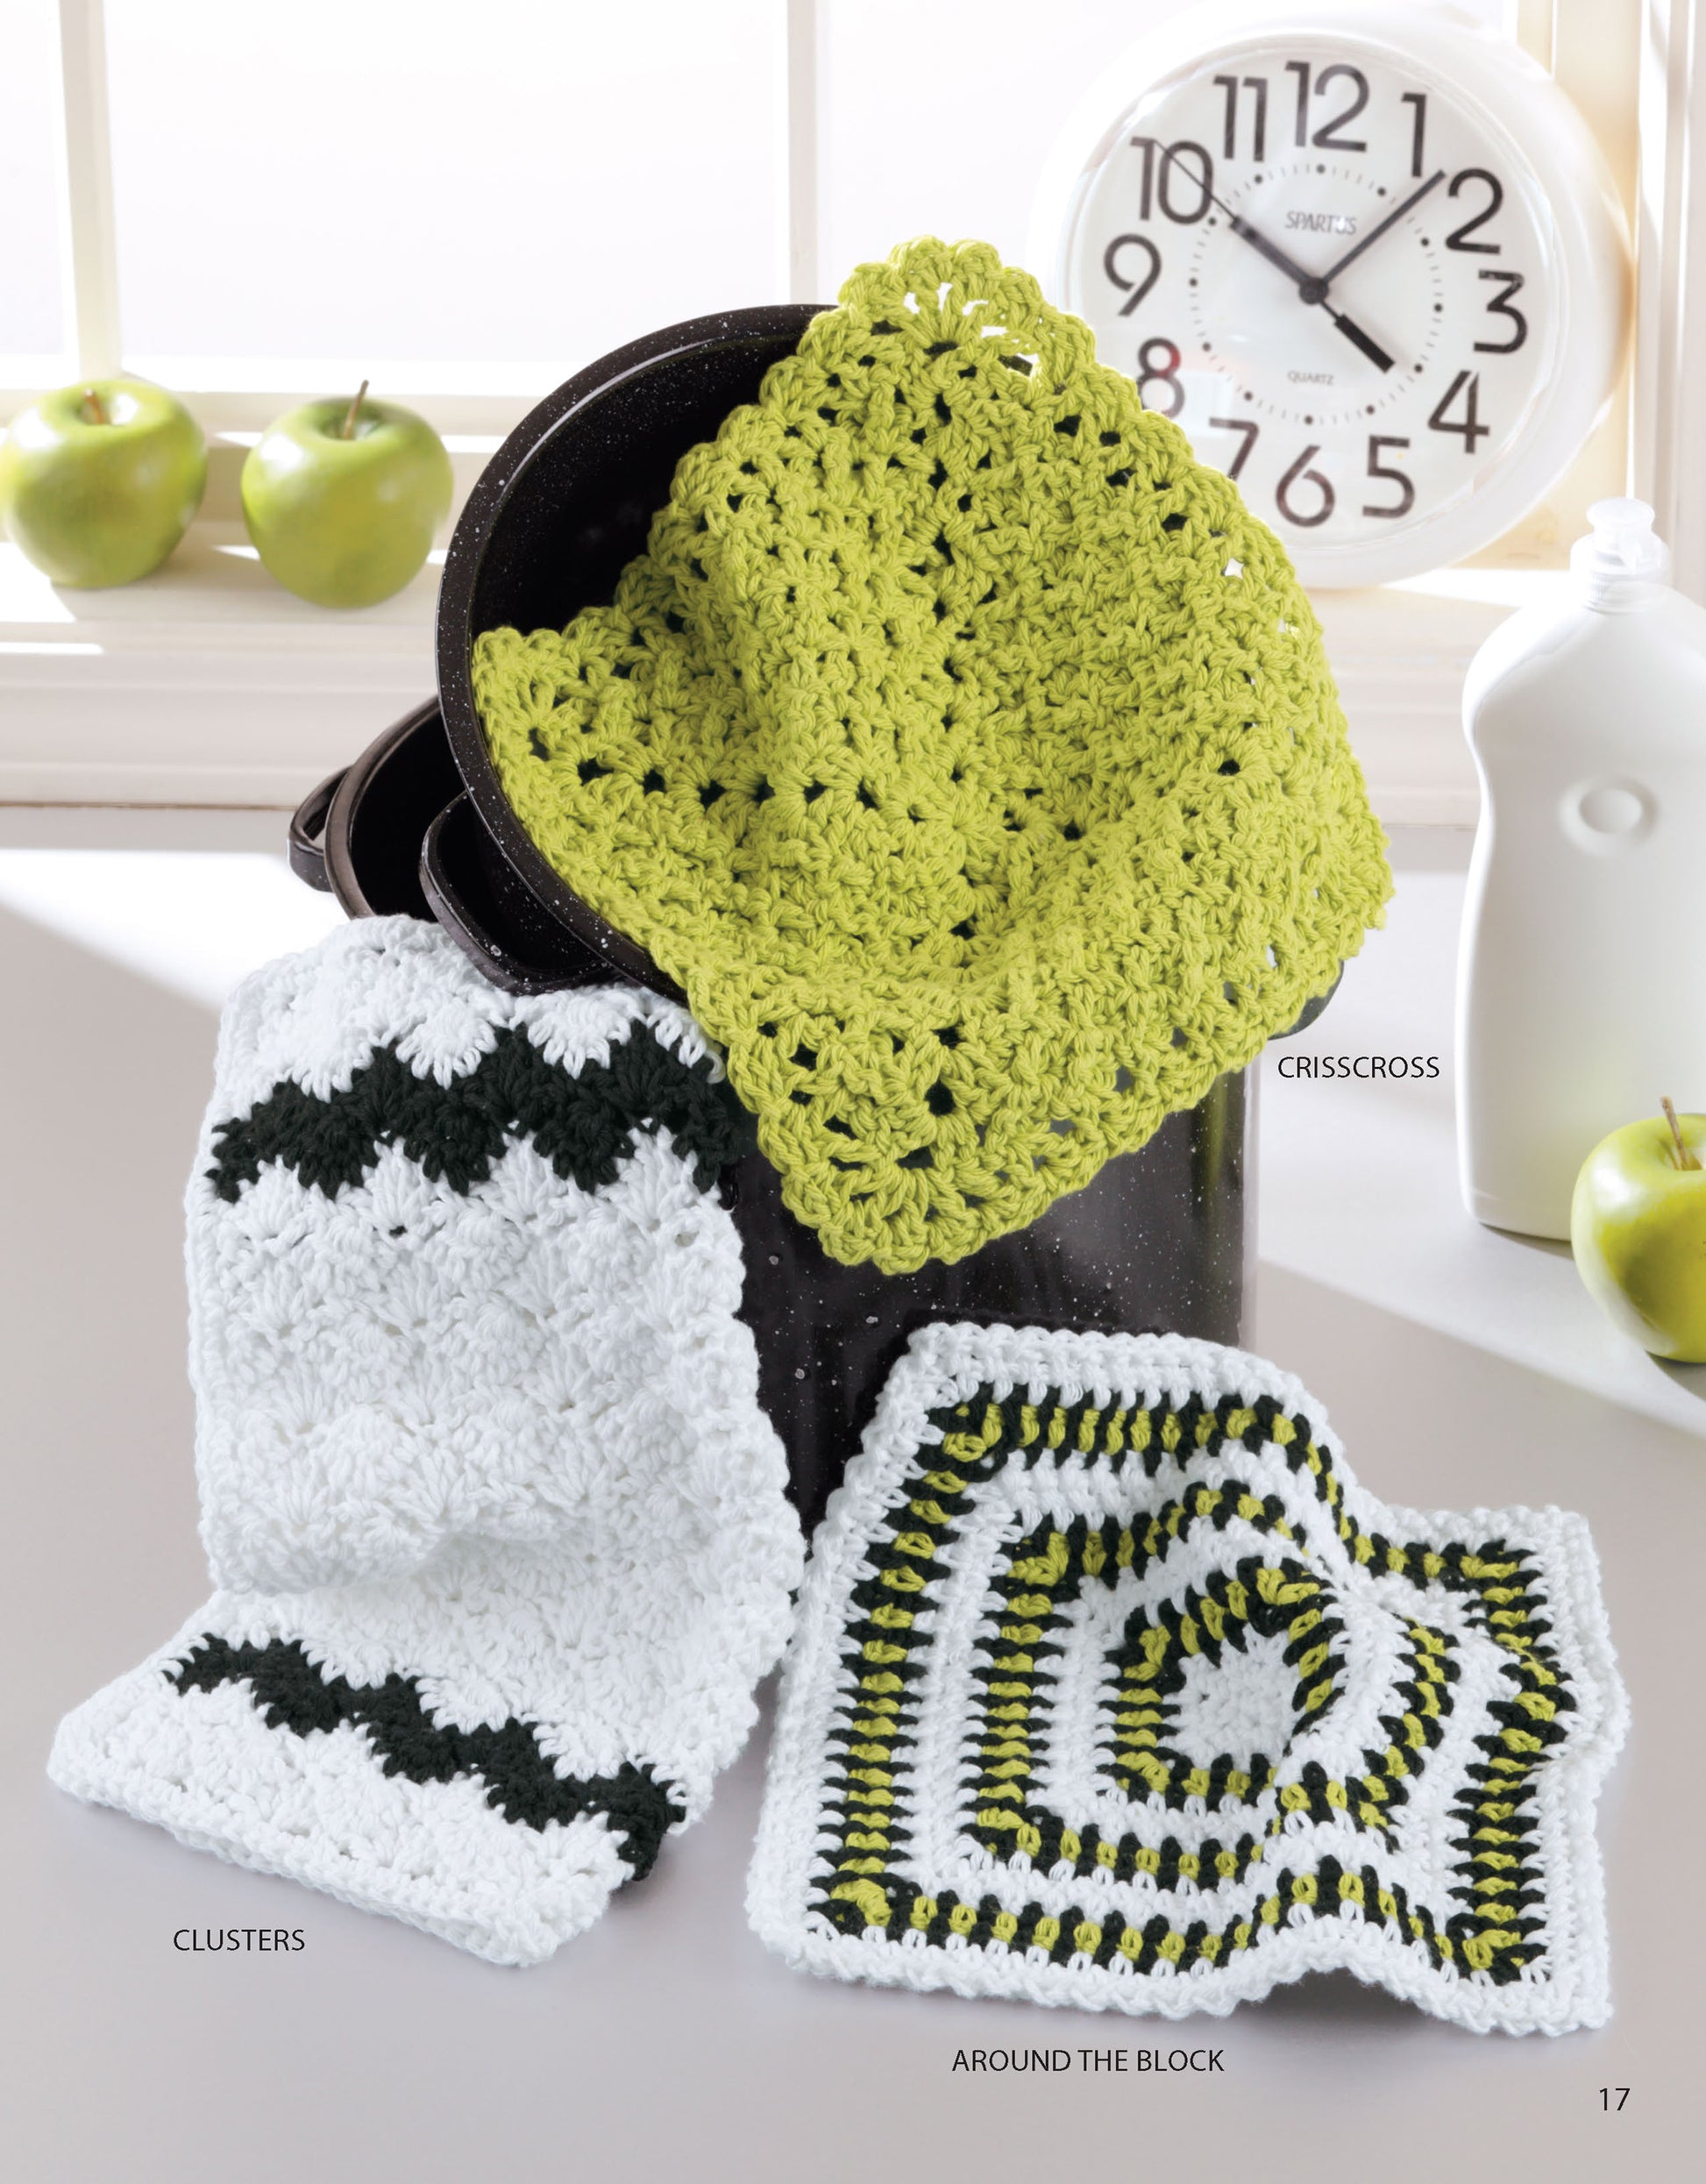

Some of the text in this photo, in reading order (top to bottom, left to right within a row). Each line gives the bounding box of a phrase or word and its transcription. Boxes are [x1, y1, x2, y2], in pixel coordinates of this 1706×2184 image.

[1212, 75, 1269, 162] 11
[1284, 60, 1370, 153] 12
[1401, 92, 1428, 178] 1
[1130, 136, 1214, 225] 10
[1445, 167, 1504, 255] 2
[1285, 210, 1358, 236] SPARTUS
[1102, 233, 1162, 317] 9
[1472, 269, 1528, 355] 3
[1136, 337, 1185, 418] 8
[1286, 370, 1335, 386] QUARTZ
[1427, 370, 1490, 454] 4
[1208, 416, 1261, 481] 7
[1275, 445, 1335, 528] 6
[1361, 435, 1416, 519] 5
